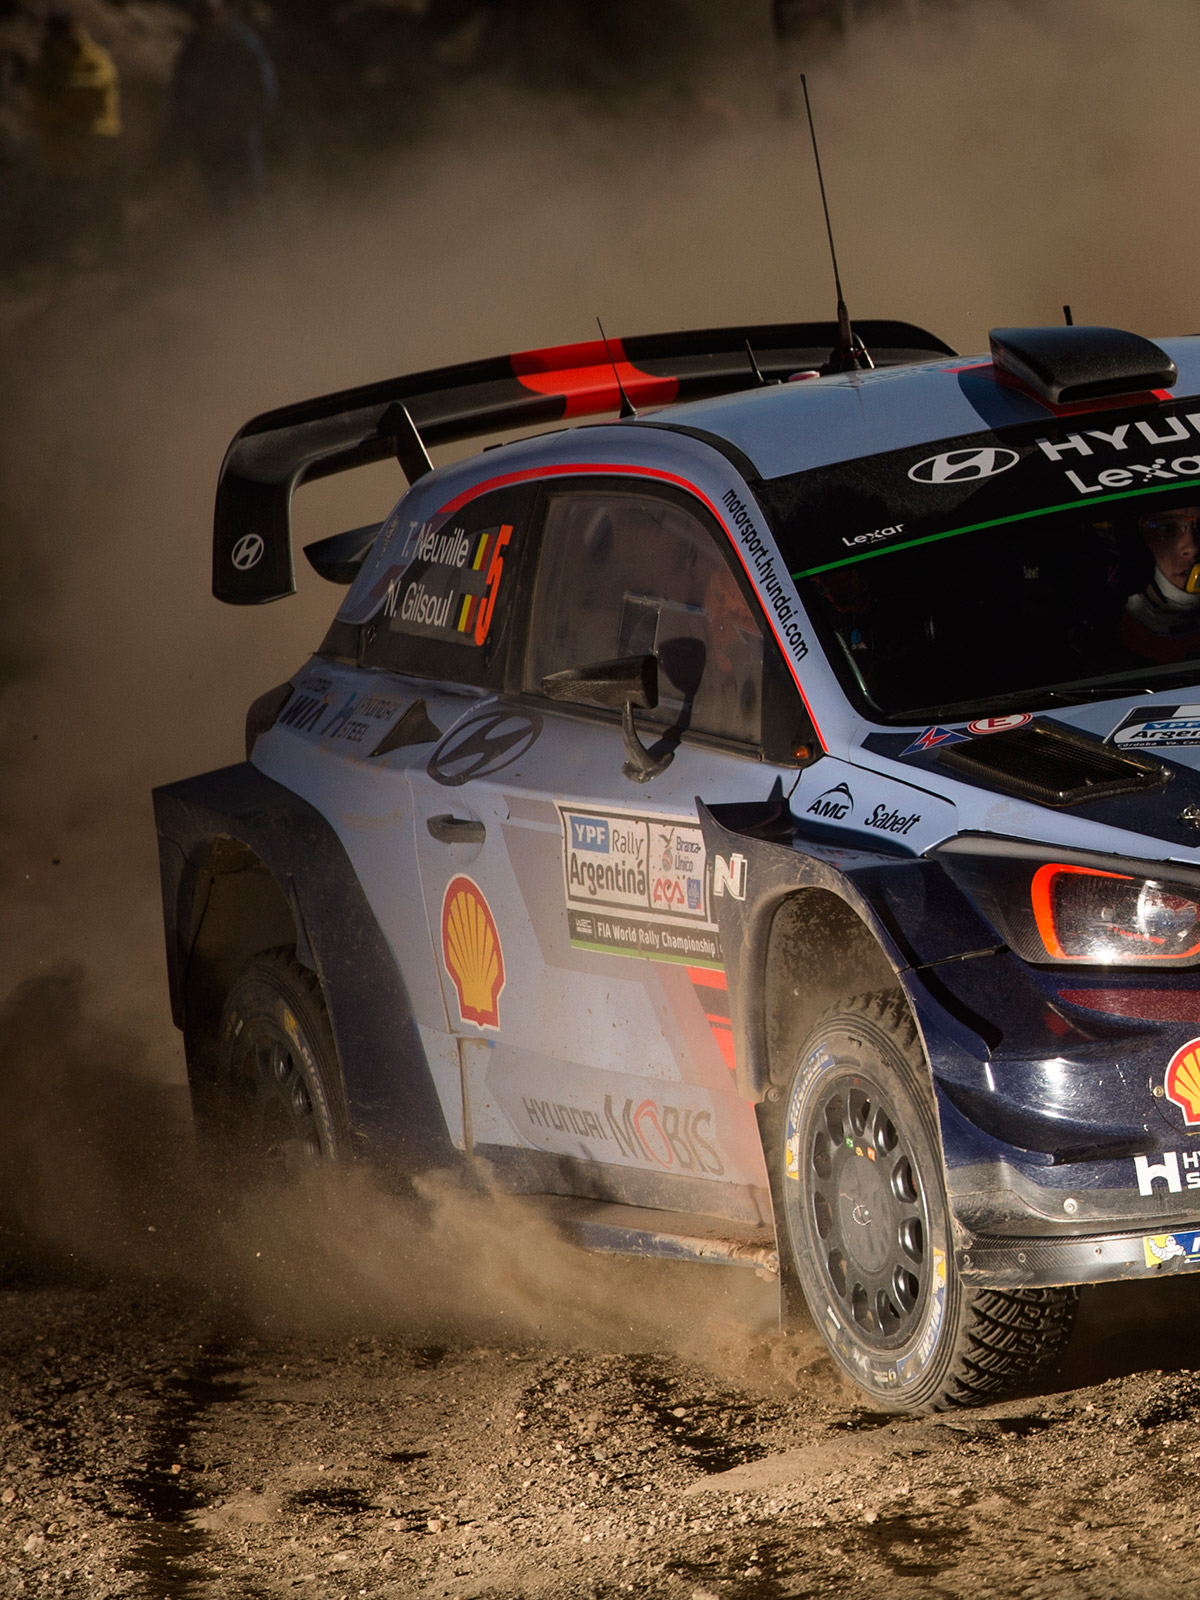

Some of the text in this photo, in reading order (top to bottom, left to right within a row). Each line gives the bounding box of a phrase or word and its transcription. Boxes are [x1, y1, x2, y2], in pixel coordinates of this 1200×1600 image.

[412, 522, 470, 569] Neuville
[841, 523, 904, 547] Lexar
[474, 524, 514, 647] 5
[721, 488, 809, 662] motorsport.hyundai.com
[402, 581, 454, 628] Gilsoul
[988, 714, 1012, 729] E
[806, 799, 850, 820] AMG
[864, 803, 922, 835] Sabelt
[574, 823, 644, 860] YPF Rally
[676, 836, 700, 854] Branca
[597, 922, 716, 956] FIA World Rally Championship
[521, 1096, 608, 1141] HYUNDAI
[604, 1094, 725, 1177] MOBIS
